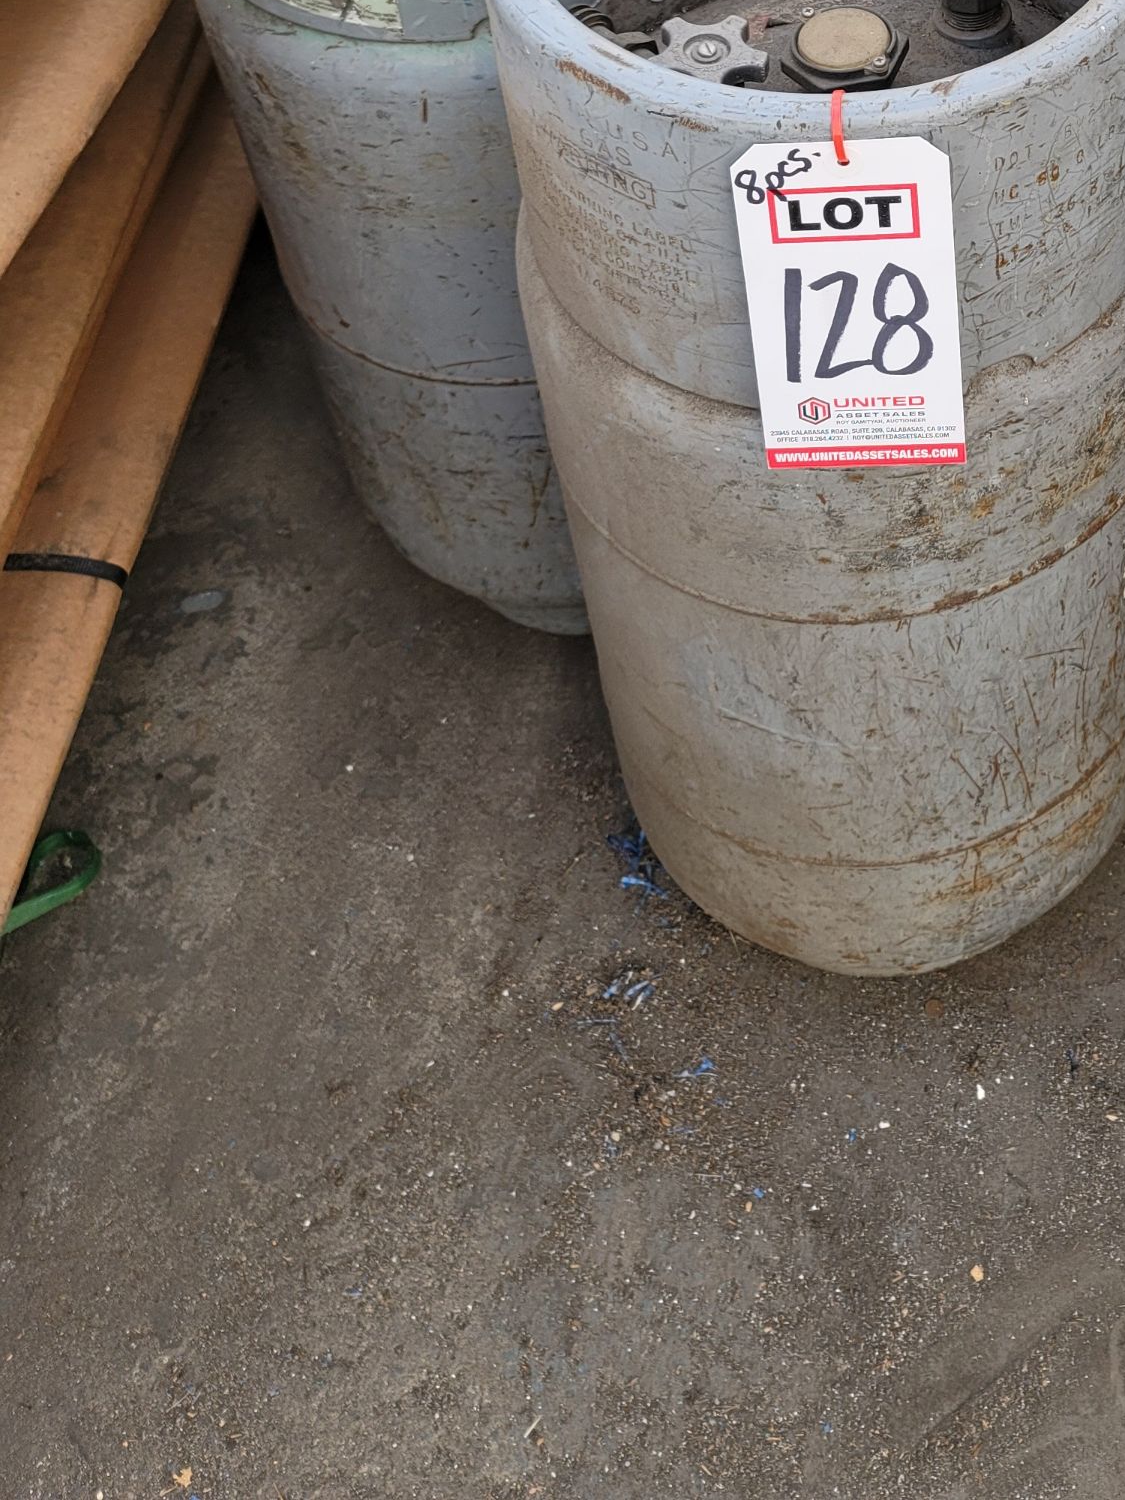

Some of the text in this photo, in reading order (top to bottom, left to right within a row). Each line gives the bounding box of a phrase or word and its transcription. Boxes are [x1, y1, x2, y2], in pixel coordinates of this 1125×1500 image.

[787, 195, 902, 231] LOT
[784, 262, 934, 383] 128
[833, 395, 925, 408] UNITED
[775, 448, 958, 462] WWW.UNITEDASSETSALES.COM
